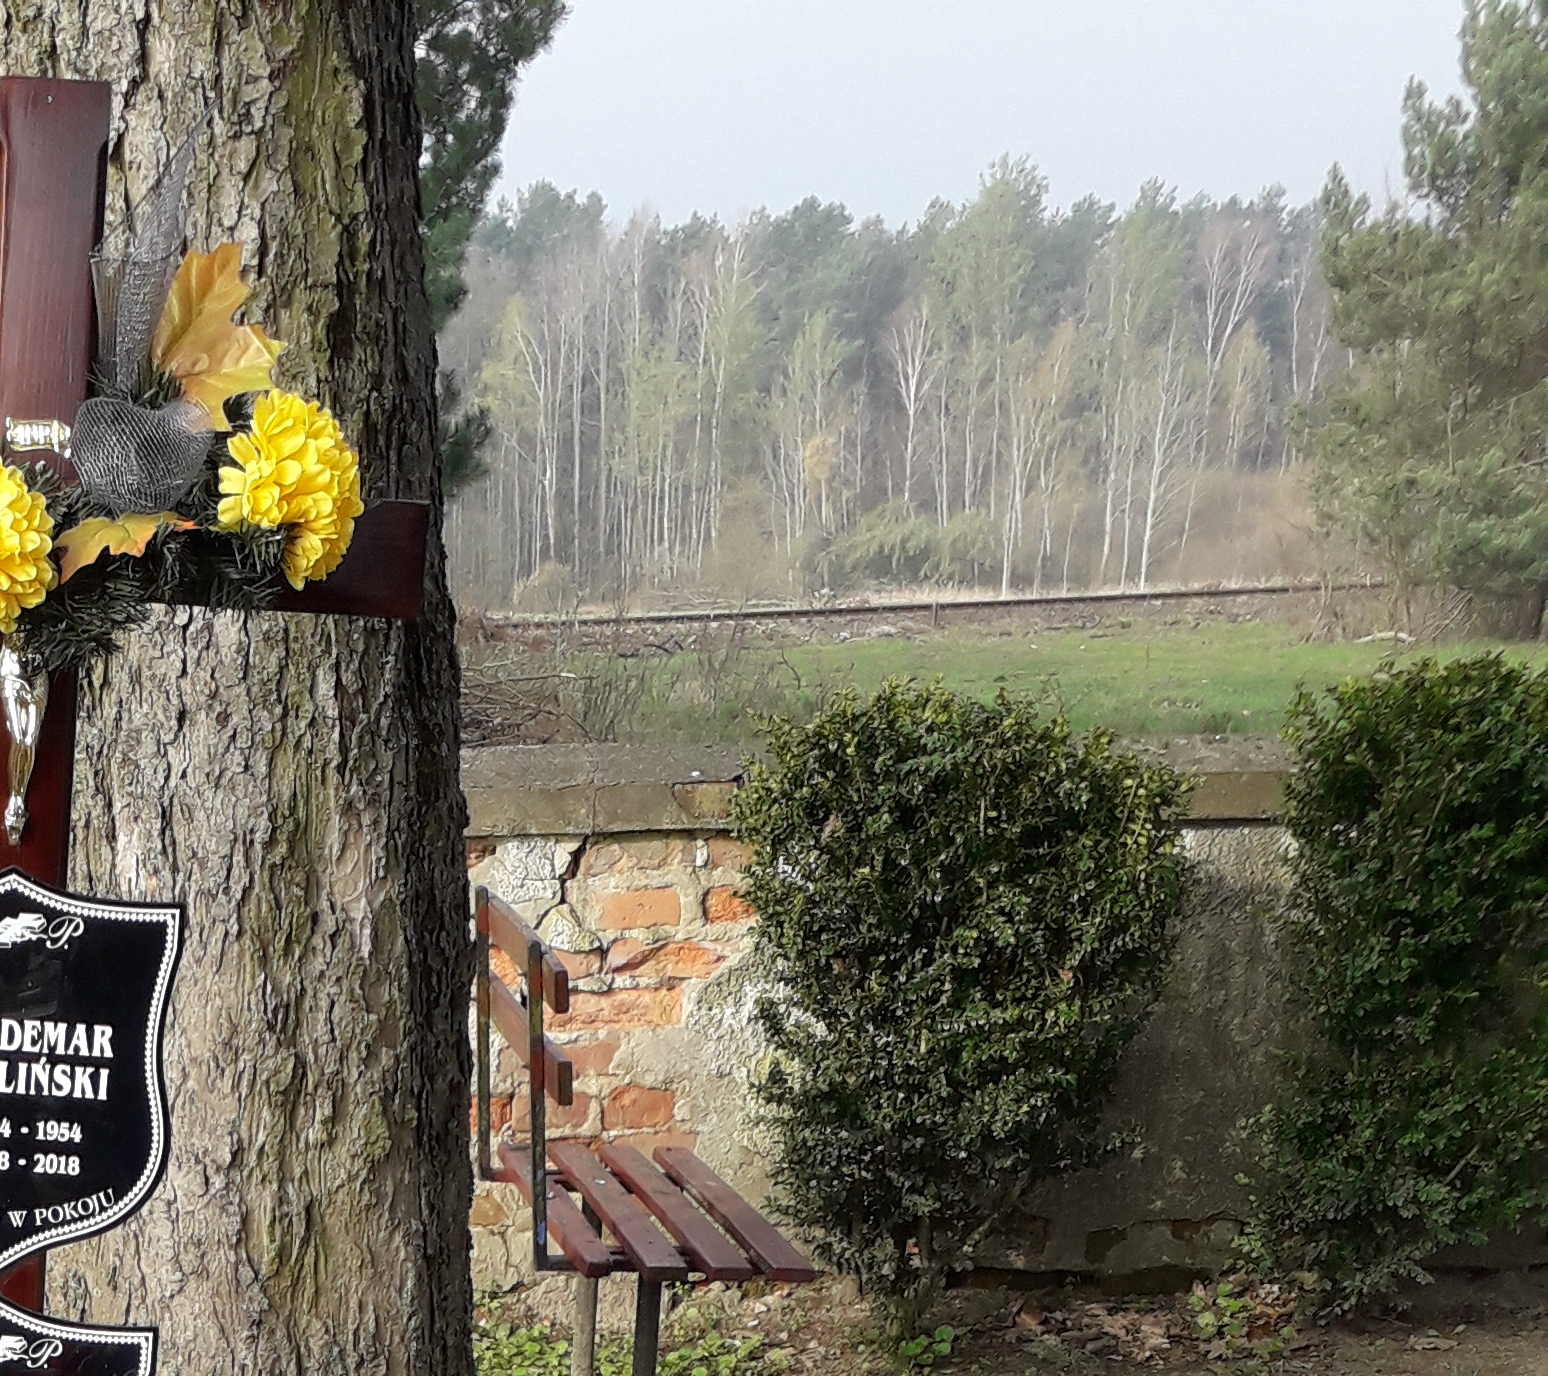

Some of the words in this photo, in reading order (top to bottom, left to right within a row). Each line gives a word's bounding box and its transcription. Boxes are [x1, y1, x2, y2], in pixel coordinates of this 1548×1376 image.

[35, 1119, 83, 1143] 1954
[32, 1153, 81, 1176] 2018
[6, 1210, 28, 1228] W
[34, 1188, 116, 1227] POKOJU
